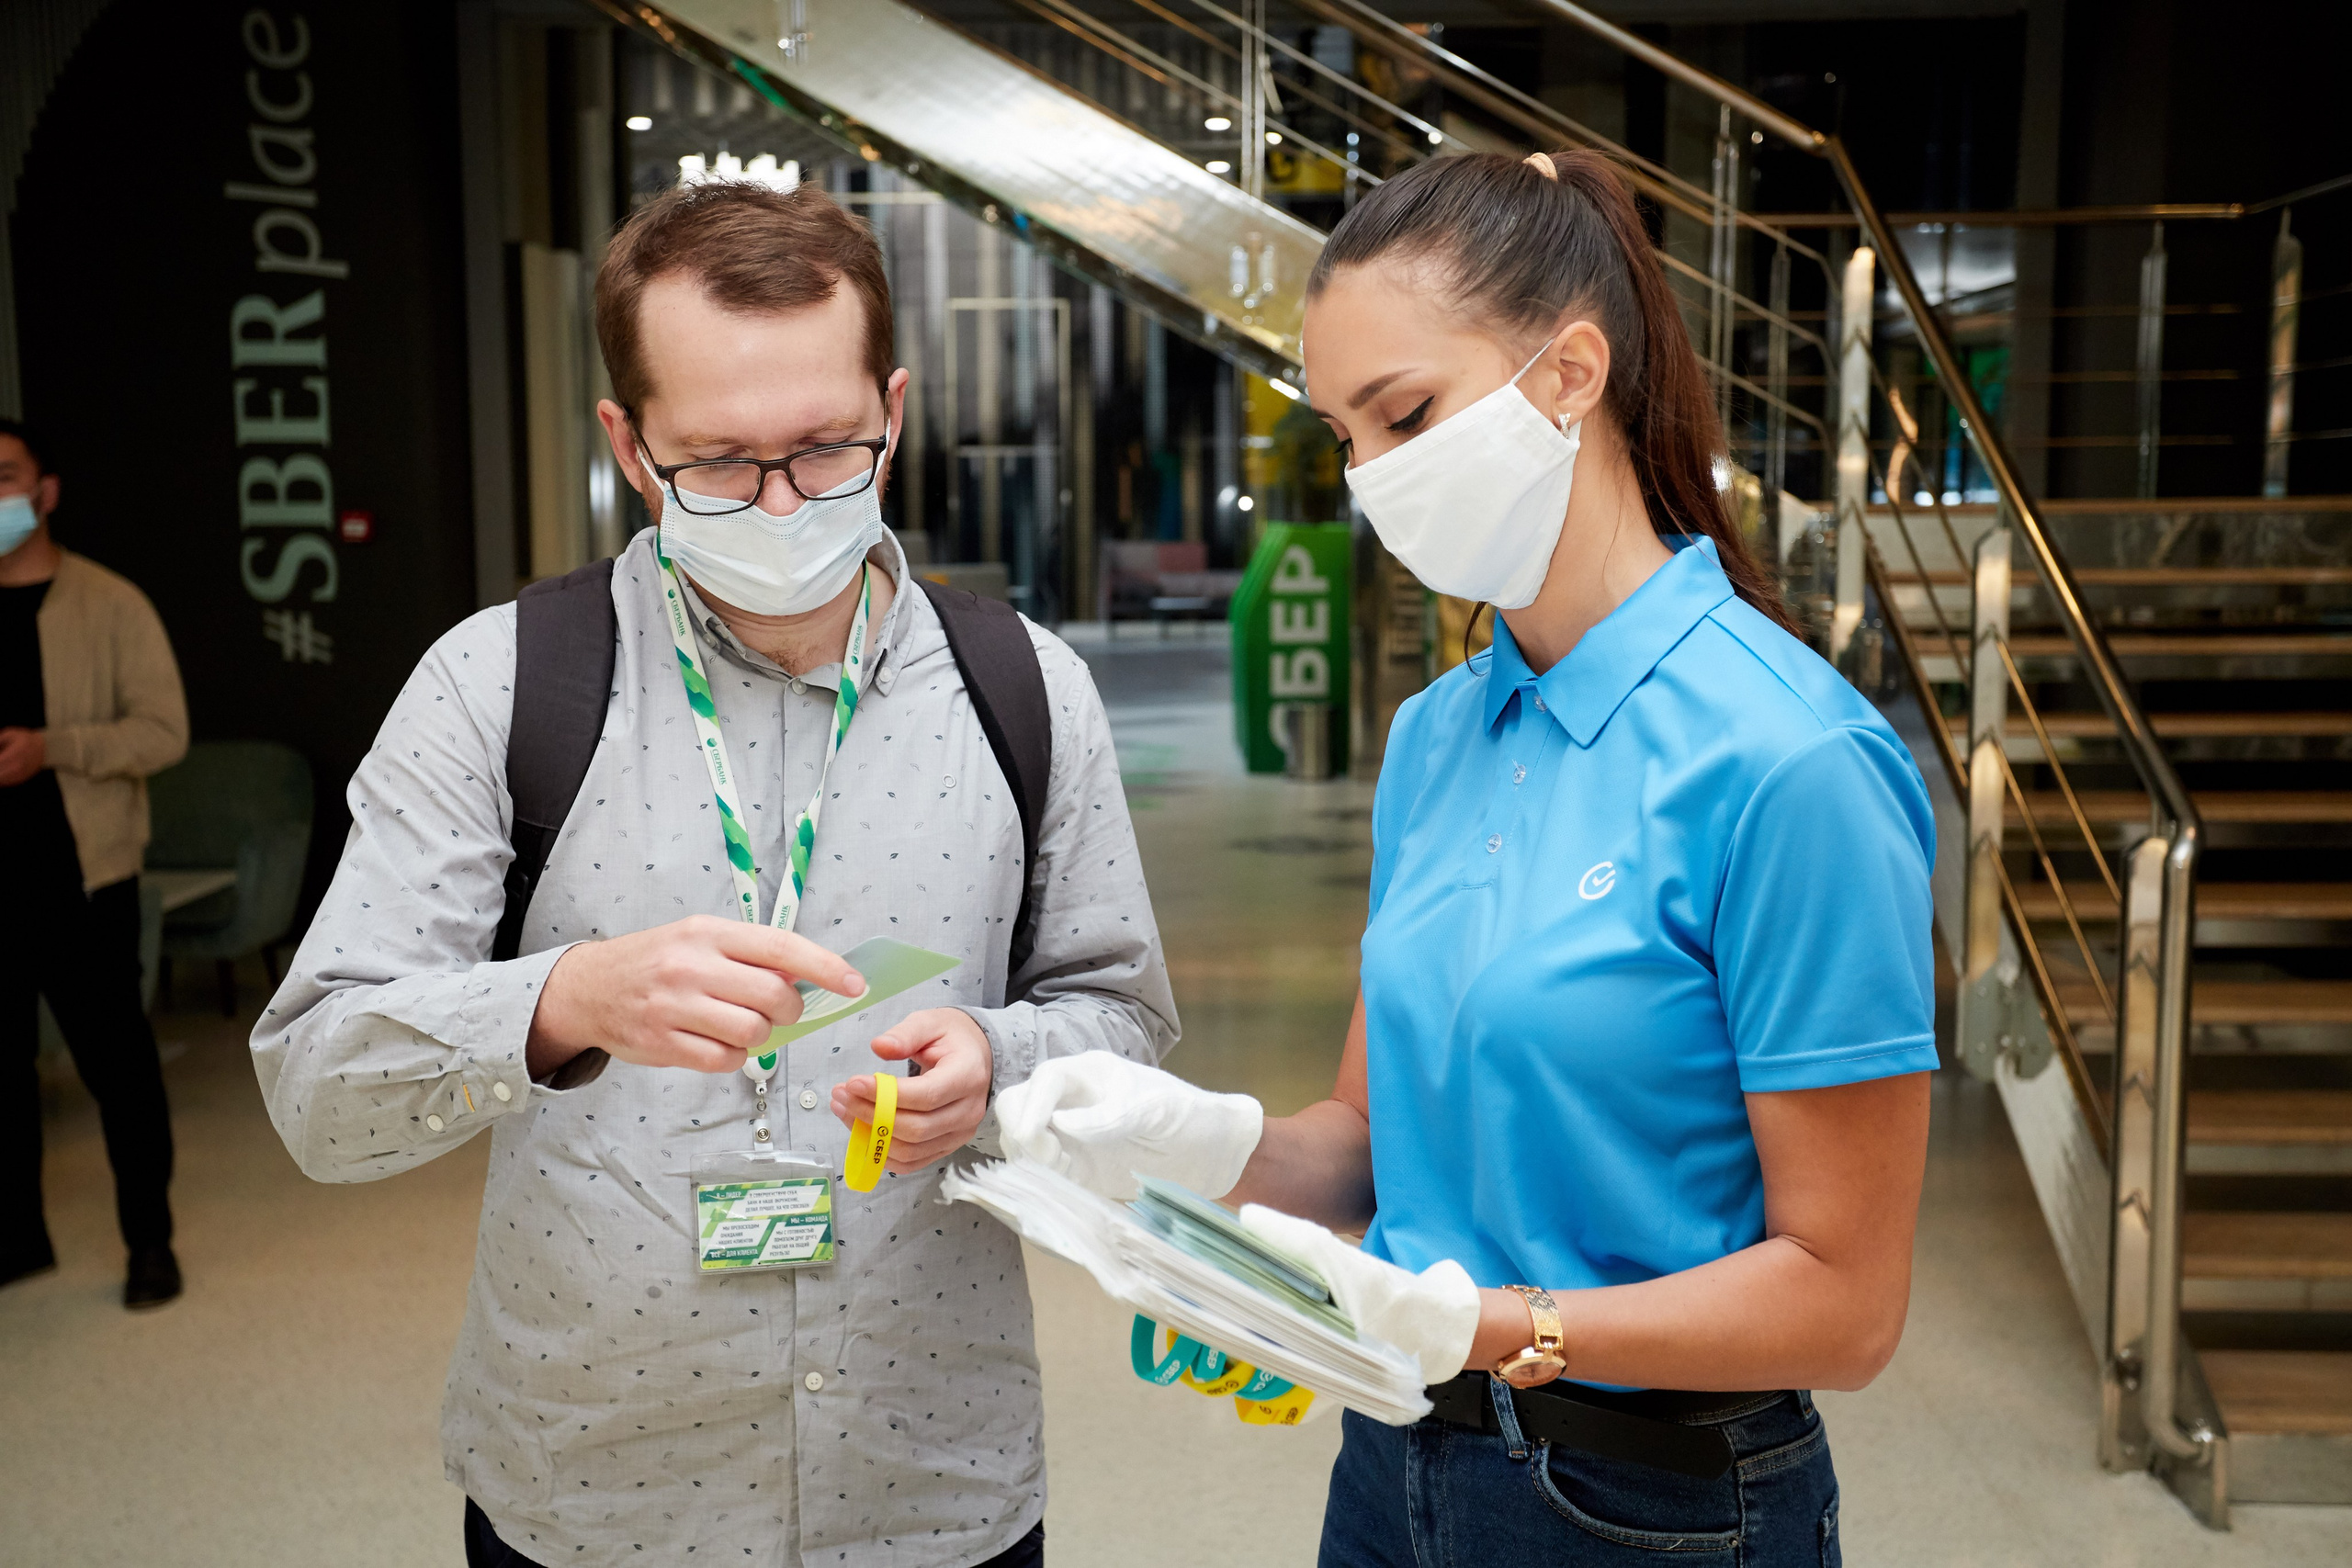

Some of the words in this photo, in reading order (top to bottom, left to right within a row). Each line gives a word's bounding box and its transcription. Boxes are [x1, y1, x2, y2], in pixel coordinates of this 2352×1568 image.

[671, 599, 686, 637] СБЕРБАНК
[711, 749, 728, 785] СБЕРБАНК
[873, 1139, 884, 1164] СБЕР
